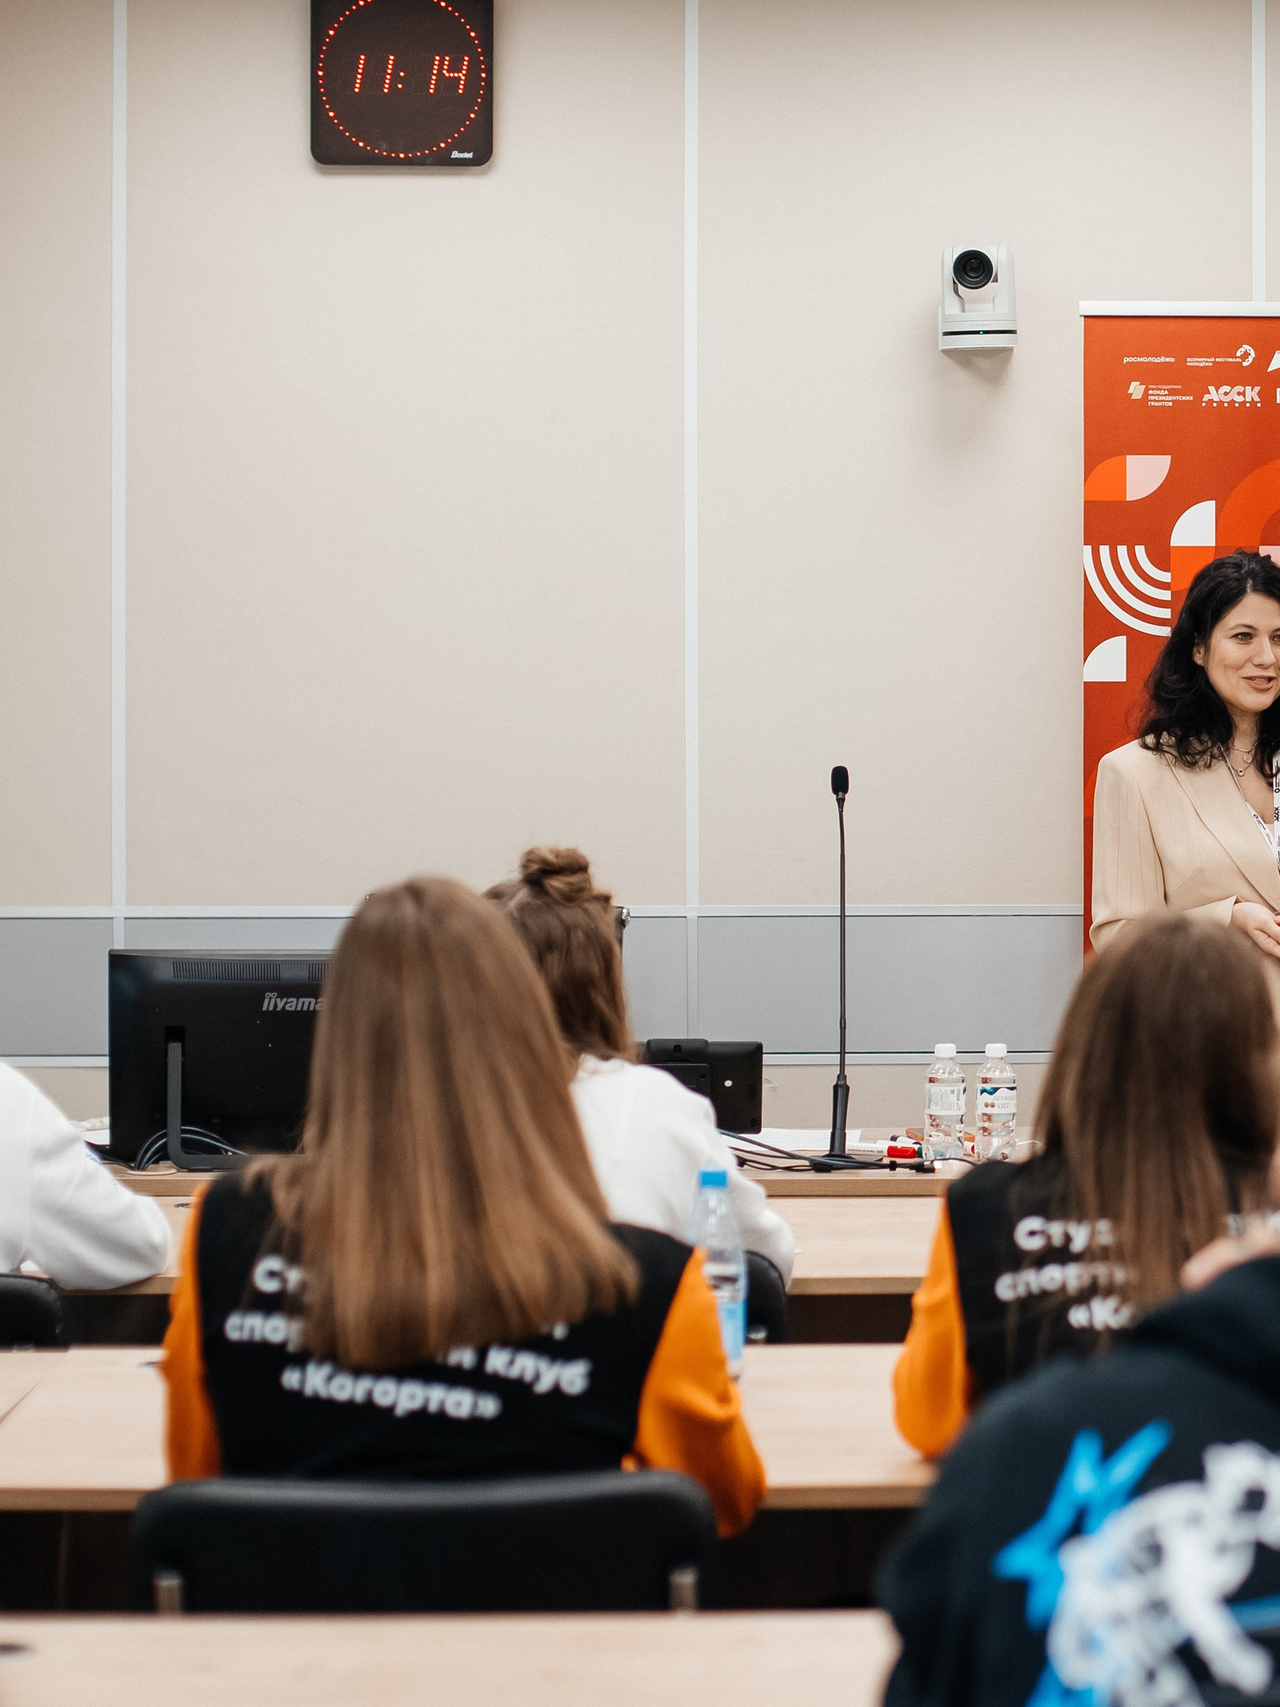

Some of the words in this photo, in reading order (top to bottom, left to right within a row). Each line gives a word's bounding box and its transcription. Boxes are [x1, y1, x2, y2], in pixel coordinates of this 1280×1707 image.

[354, 54, 469, 94] 11:14
[1123, 356, 1175, 364] росмолодёжь
[1202, 385, 1261, 402] АССК
[280, 1360, 503, 1420] «Когорта»
[484, 1344, 592, 1397] клуб
